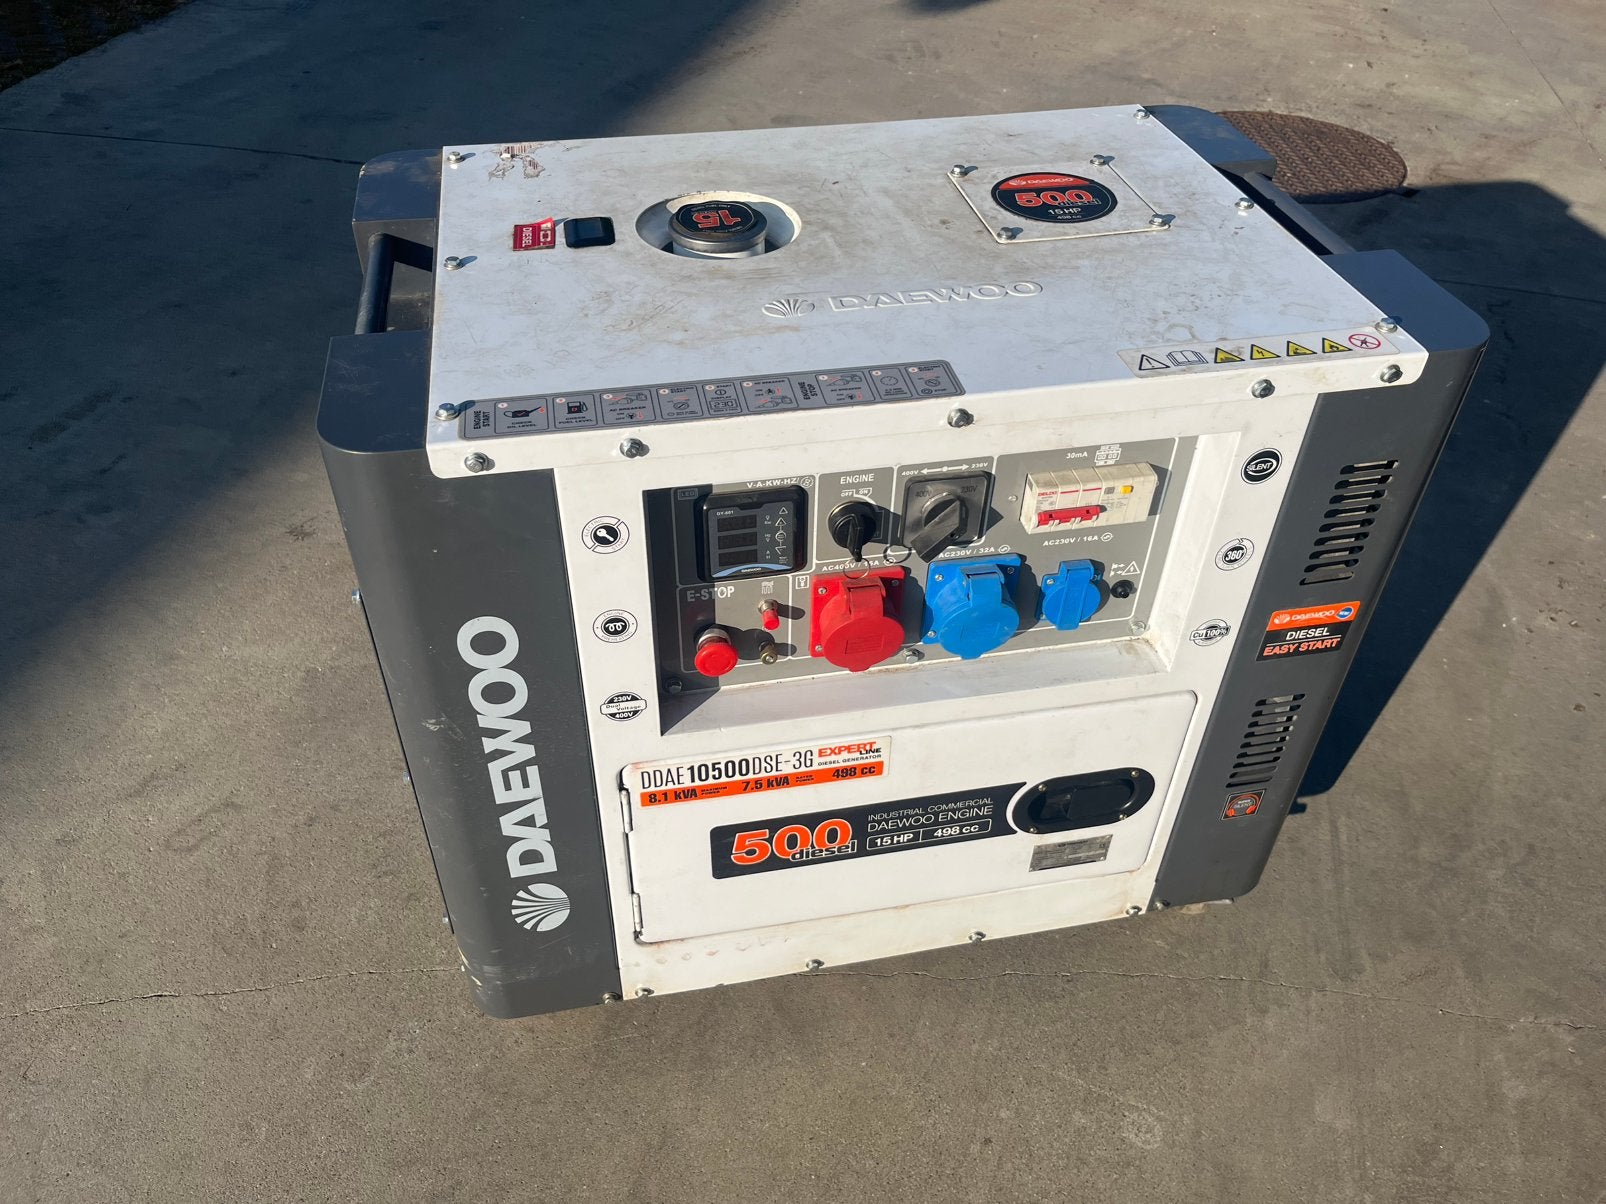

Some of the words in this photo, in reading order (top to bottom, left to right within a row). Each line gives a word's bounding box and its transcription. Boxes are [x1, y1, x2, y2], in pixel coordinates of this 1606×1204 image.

[1014, 190, 1094, 207] 500
[692, 209, 742, 229] 15
[522, 227, 533, 248] DIESEL
[828, 280, 1044, 312] DAEWOO
[798, 381, 811, 400] ENGINE
[807, 383, 818, 397] STOP
[473, 410, 482, 430] ENGINE
[482, 411, 491, 428] START
[1066, 451, 1088, 459] 30mA
[1246, 462, 1273, 471] SILENT
[840, 473, 875, 484] ENGINE
[1042, 536, 1076, 546] AC230V
[1082, 534, 1099, 542] 16A
[938, 549, 972, 559] AC230V
[686, 585, 735, 602] E-STOP
[1292, 609, 1335, 621] DAEWOO
[1286, 627, 1330, 640] DIESEL
[1263, 643, 1298, 657] EASY
[1299, 638, 1341, 652] START
[457, 615, 558, 879] DAEWOO
[818, 741, 877, 758] EXPERT
[859, 747, 882, 756] LINE
[818, 759, 841, 767] DIESEL
[842, 753, 882, 763] GENERATOR
[640, 748, 814, 790] DDAE10500DSE-3G
[832, 766, 857, 778] 498
[860, 765, 876, 775] cc
[741, 780, 763, 792] 7.5
[766, 775, 790, 788] kVA
[648, 791, 669, 804] 8.1
[673, 788, 698, 801] kVA
[868, 806, 926, 821] INDUSTRIAL
[927, 797, 994, 813] COMMERCIAL
[867, 814, 935, 833] DAEWOO
[938, 805, 994, 822] ENGINE
[933, 825, 960, 838] 498
[962, 824, 979, 834] cc
[730, 818, 853, 866] 500
[790, 839, 857, 863] diesel
